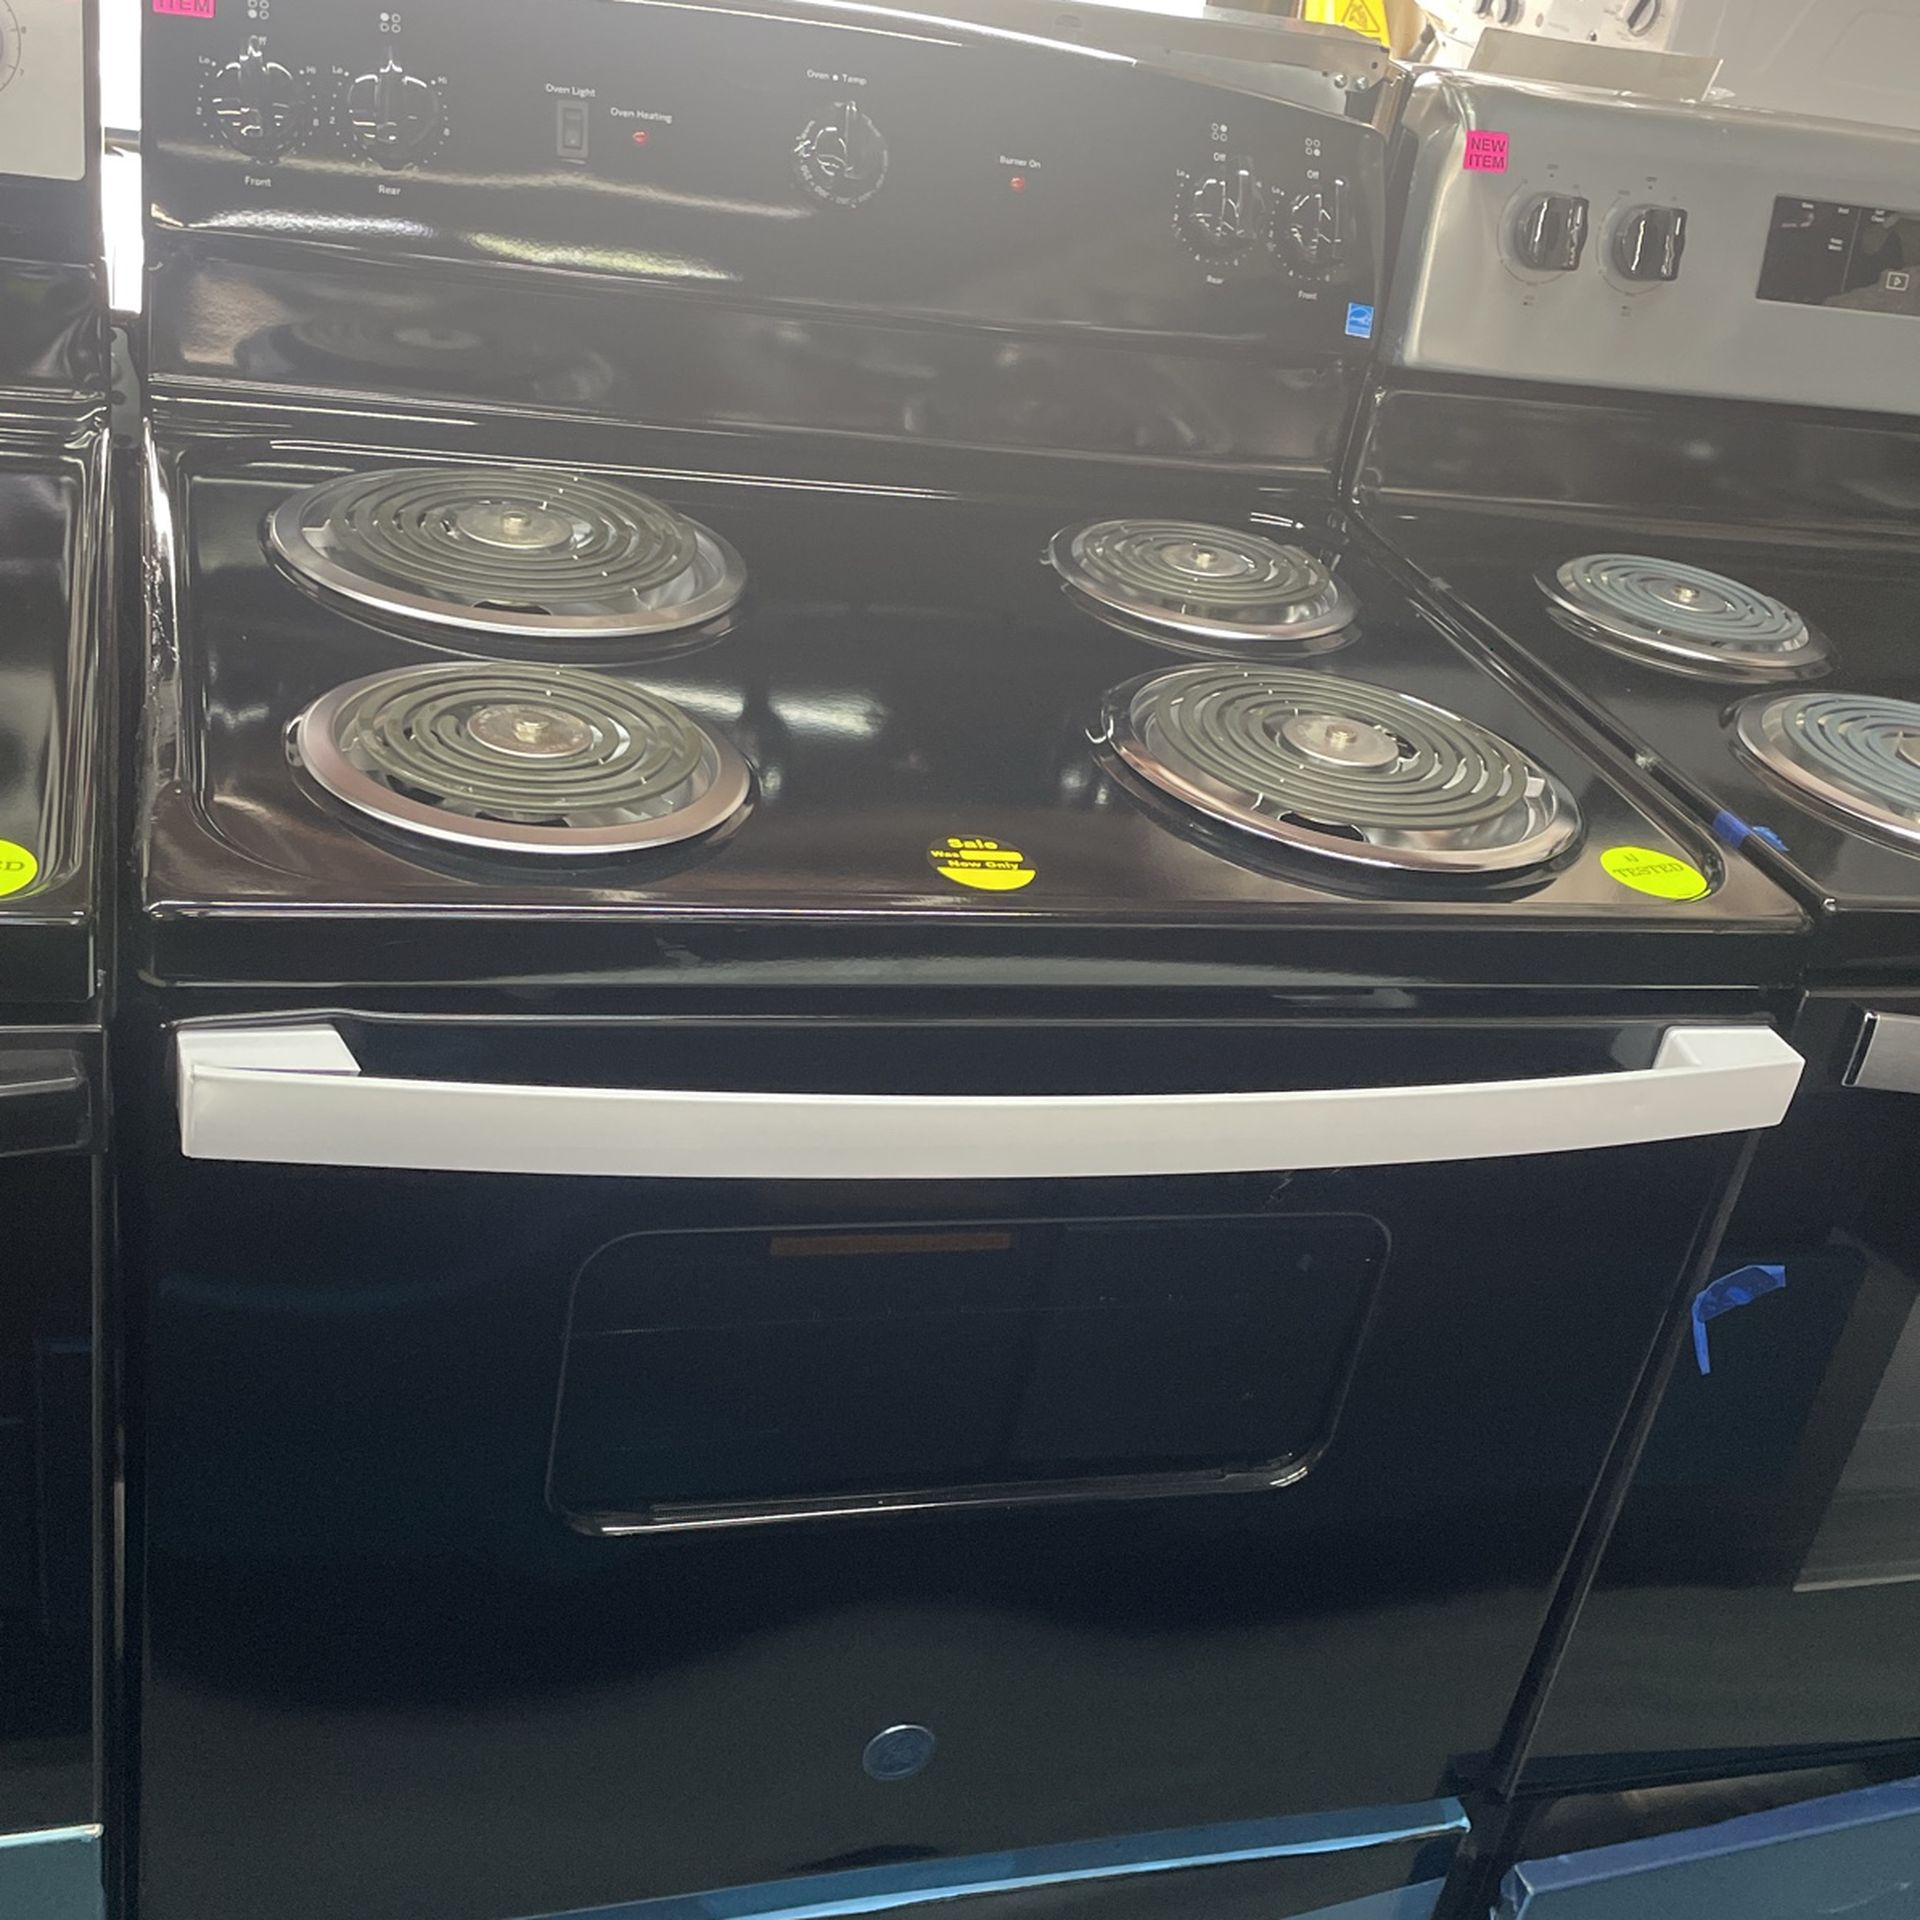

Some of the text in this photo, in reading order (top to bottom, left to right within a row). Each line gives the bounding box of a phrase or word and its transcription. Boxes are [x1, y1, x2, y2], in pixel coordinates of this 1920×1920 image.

[159, 0, 210, 13] ITEM
[807, 69, 867, 86] Oven Temp
[545, 83, 596, 98] Oven Light
[610, 107, 673, 124] Oven Heating
[1471, 137, 1506, 152] NEW
[1029, 159, 1041, 168] On
[1469, 154, 1505, 169] ITEM
[245, 175, 272, 187] Front
[378, 184, 401, 196] Rear
[946, 838, 998, 850] Sale
[948, 859, 1019, 871] Now Only
[1612, 862, 1685, 878] TESTED
